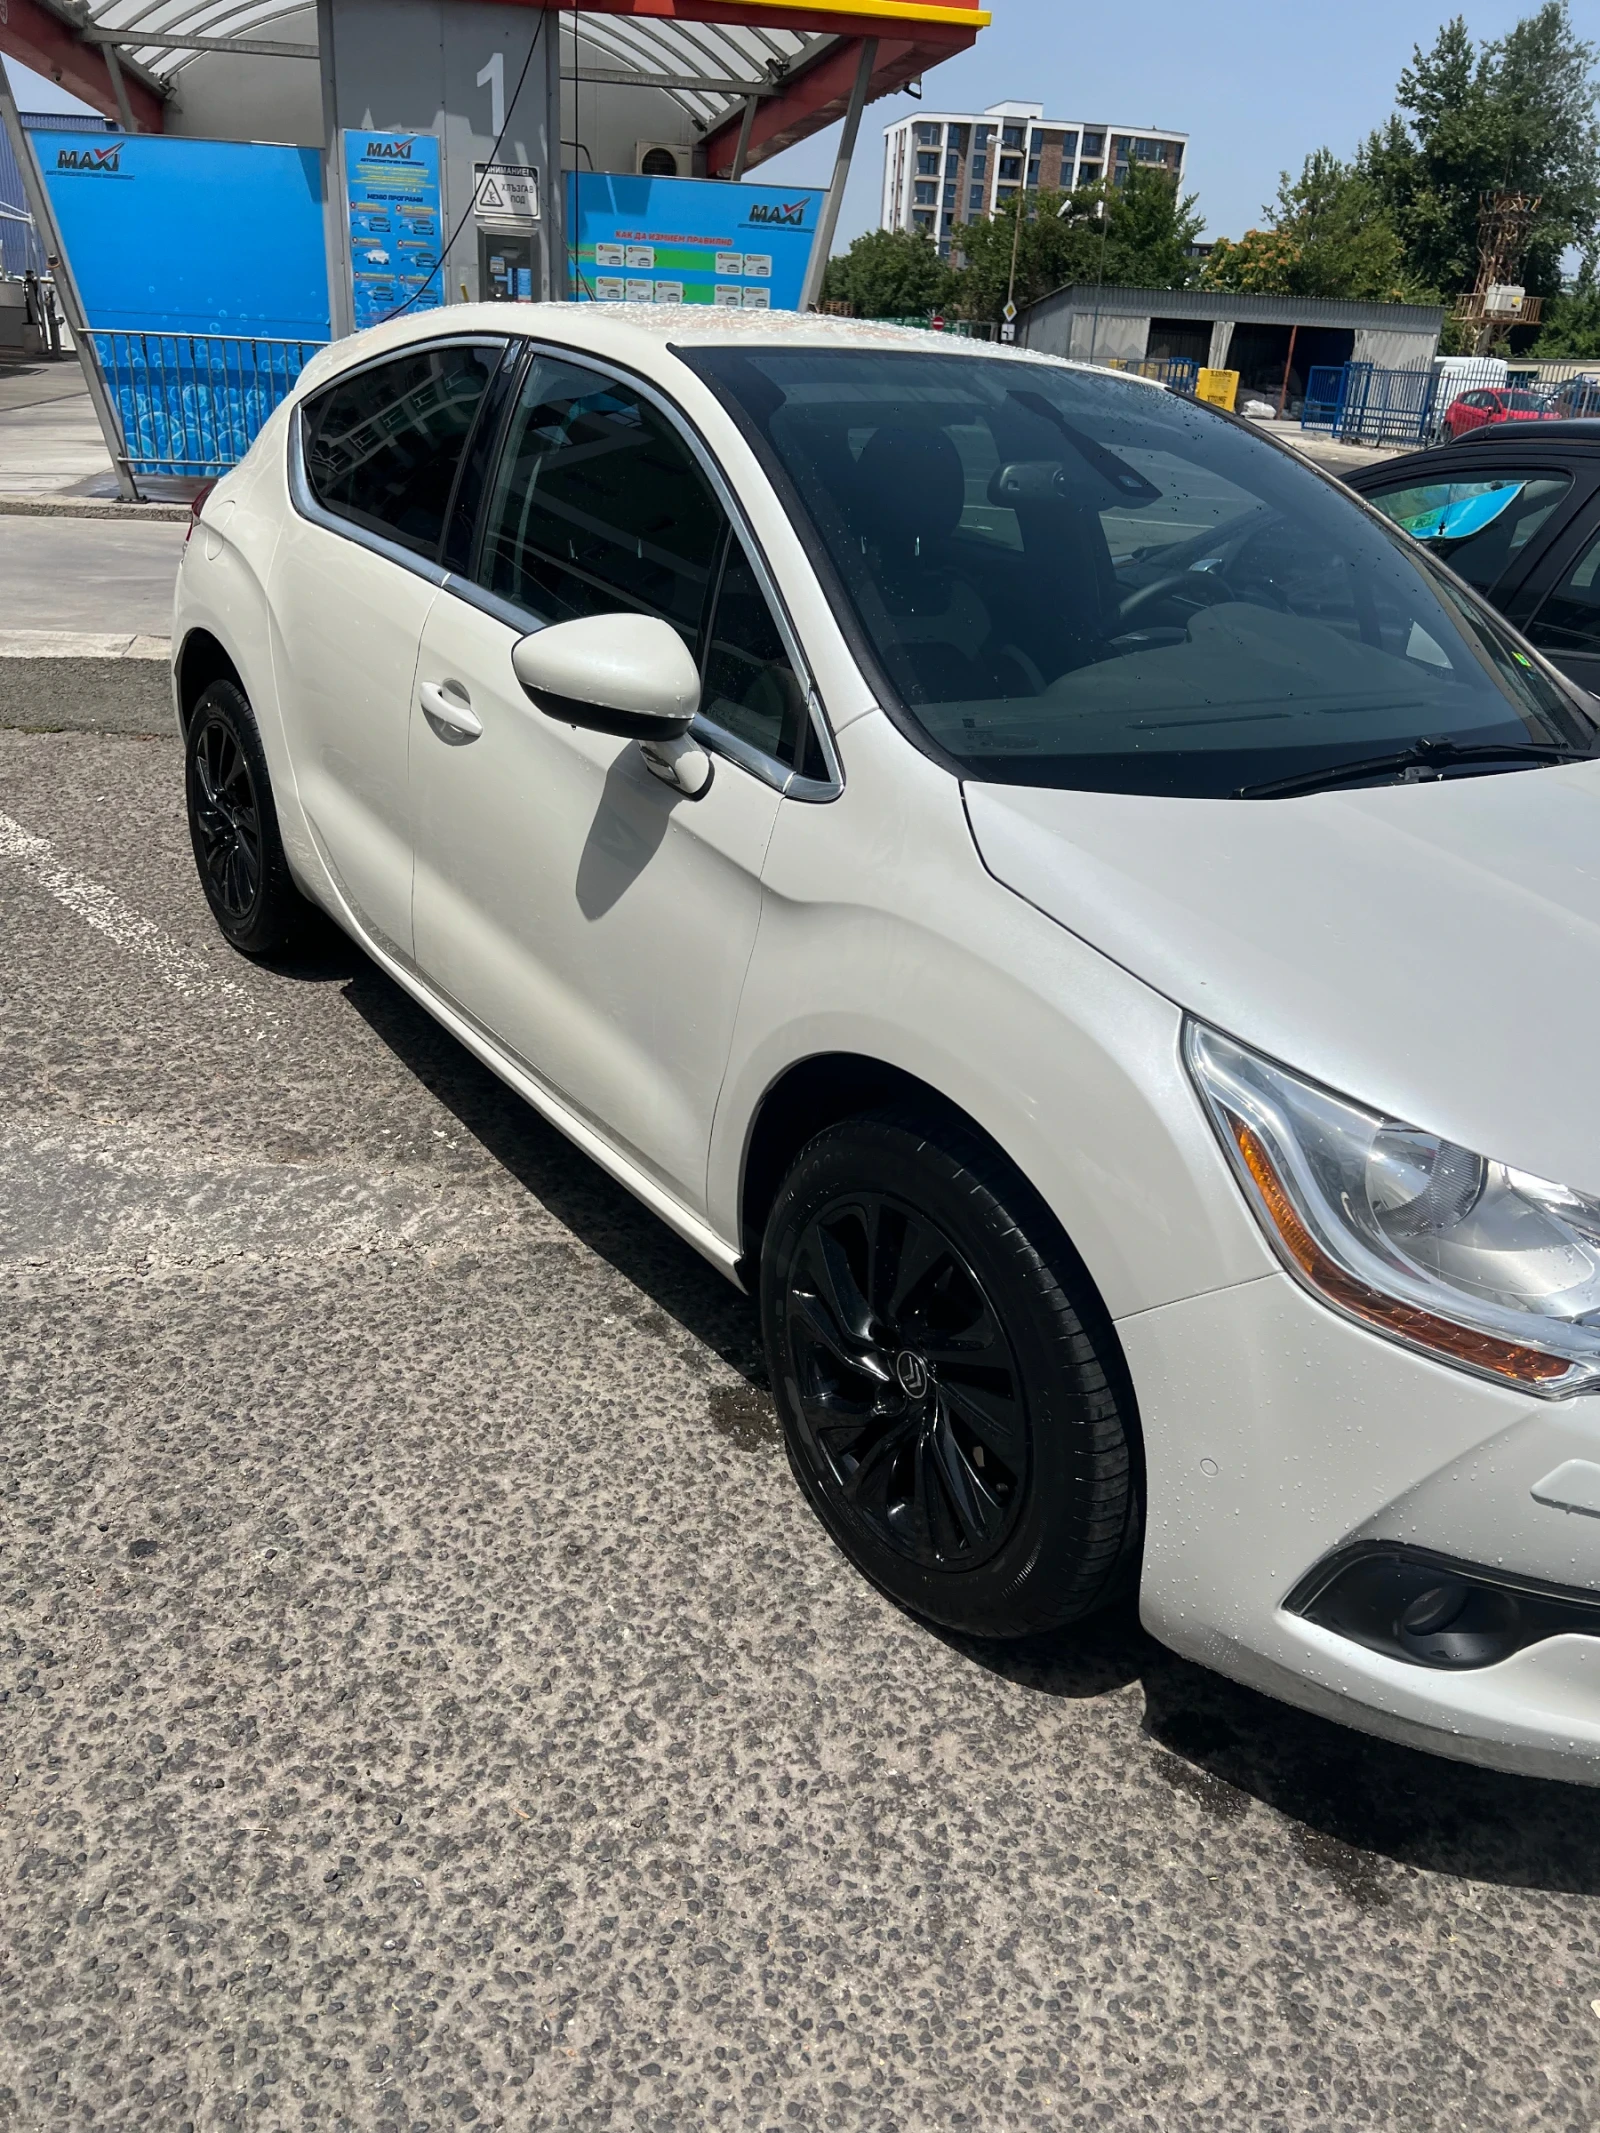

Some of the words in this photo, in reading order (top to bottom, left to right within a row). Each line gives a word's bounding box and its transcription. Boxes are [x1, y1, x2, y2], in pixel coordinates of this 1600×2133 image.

[476, 52, 505, 137] 1
[57, 141, 125, 172] MAXI
[366, 136, 417, 159] MAXI
[501, 183, 534, 194] ХЛЪЗГАВ
[388, 194, 424, 203] ПРОГРАМИ
[510, 195, 526, 205] ПОД
[748, 197, 811, 226] MAXI
[615, 230, 633, 239] КАК
[634, 232, 647, 241] ДА
[686, 235, 733, 246] ПРАВИЛНО
